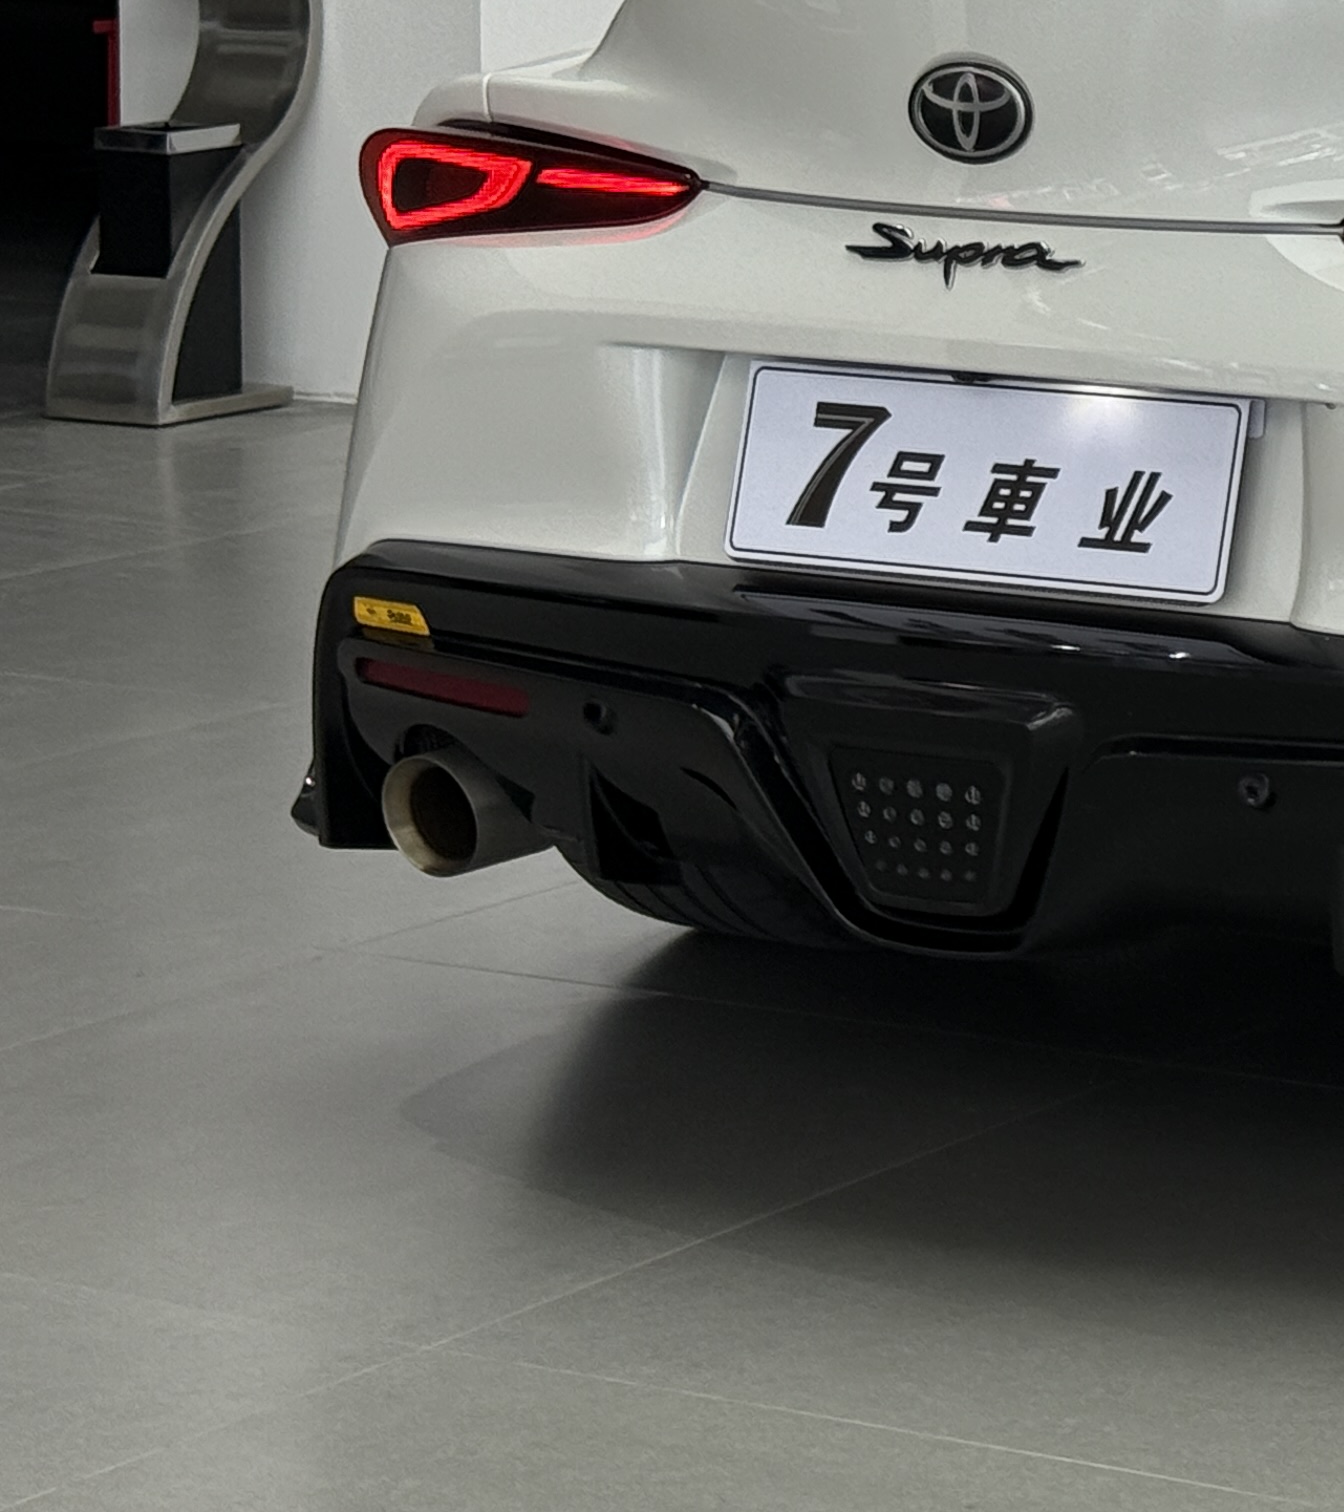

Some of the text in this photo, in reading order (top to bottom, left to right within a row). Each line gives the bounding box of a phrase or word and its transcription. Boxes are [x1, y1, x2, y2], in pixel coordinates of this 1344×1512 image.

[845, 222, 1085, 290] Supra
[785, 401, 1174, 554] 7号車业
